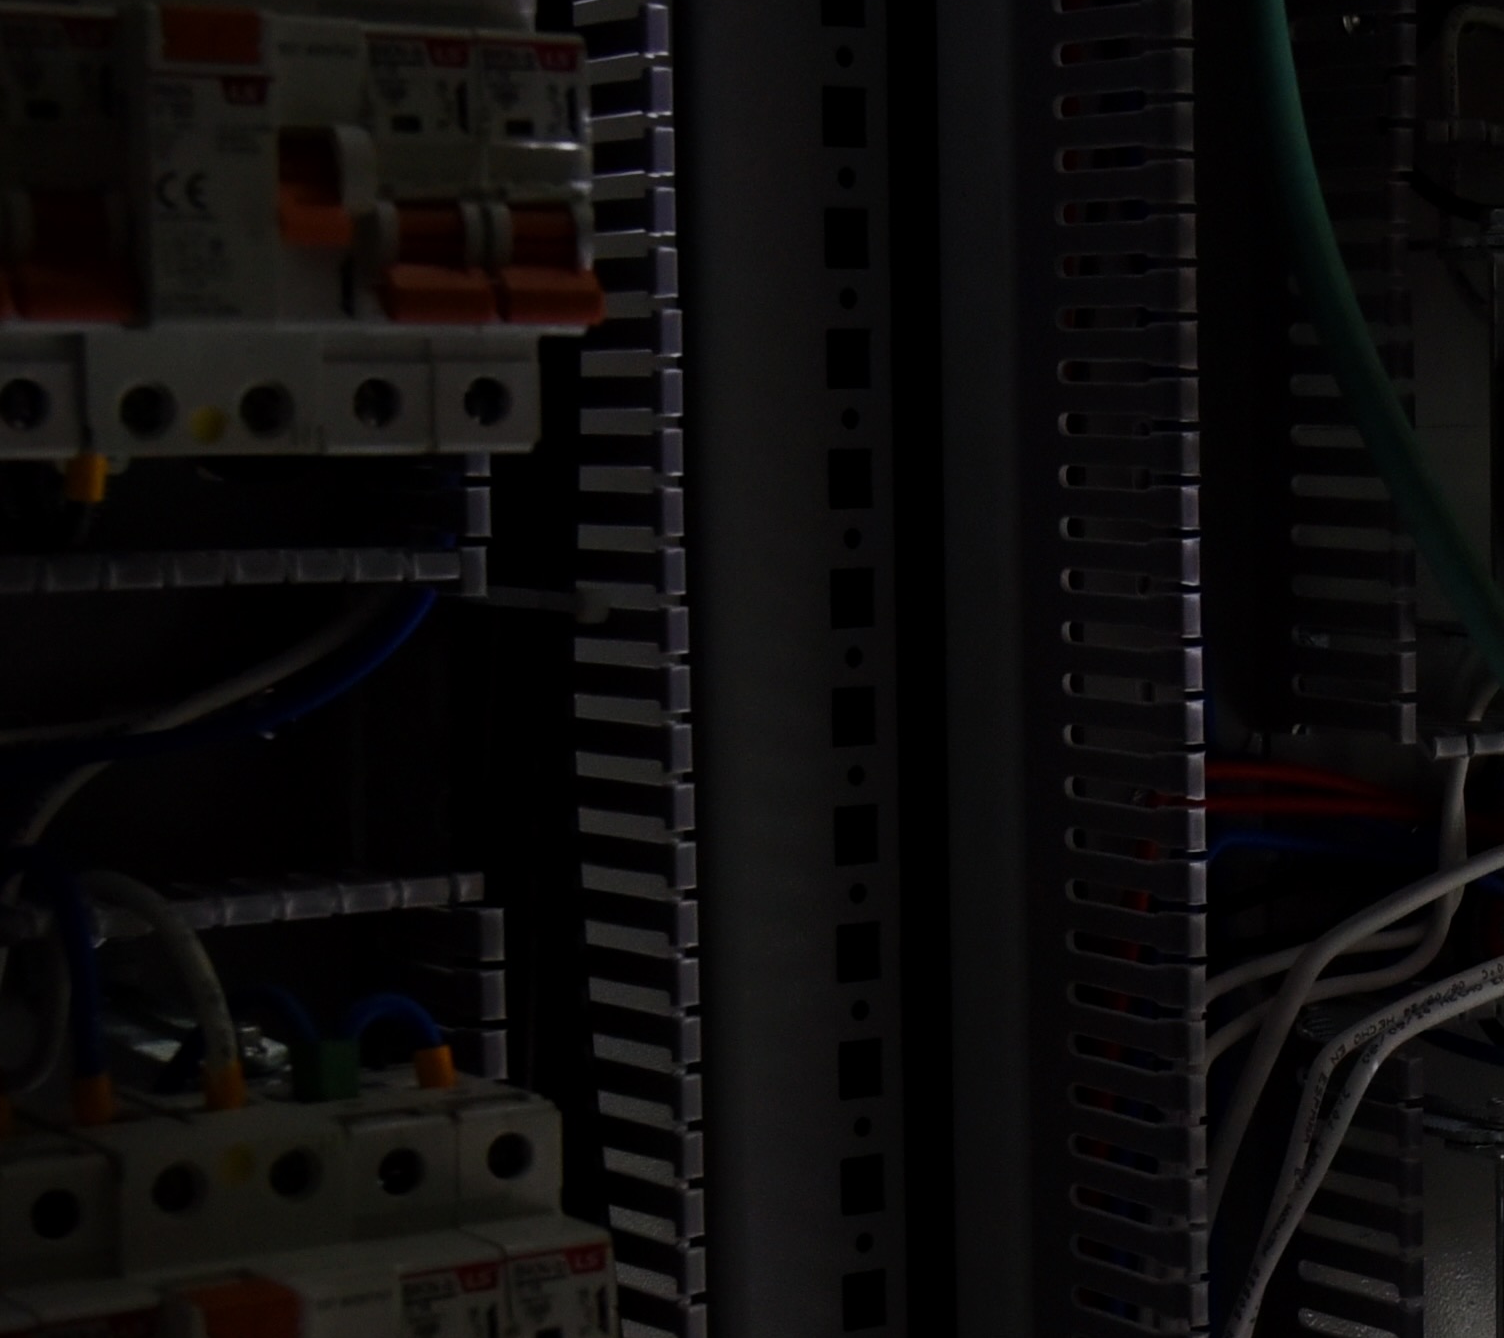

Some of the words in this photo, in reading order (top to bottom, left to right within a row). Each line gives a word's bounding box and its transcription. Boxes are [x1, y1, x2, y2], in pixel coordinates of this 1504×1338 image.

[157, 172, 206, 210] CE
[1353, 1015, 1395, 1046] HECHO
[1330, 1046, 1346, 1066] EN
